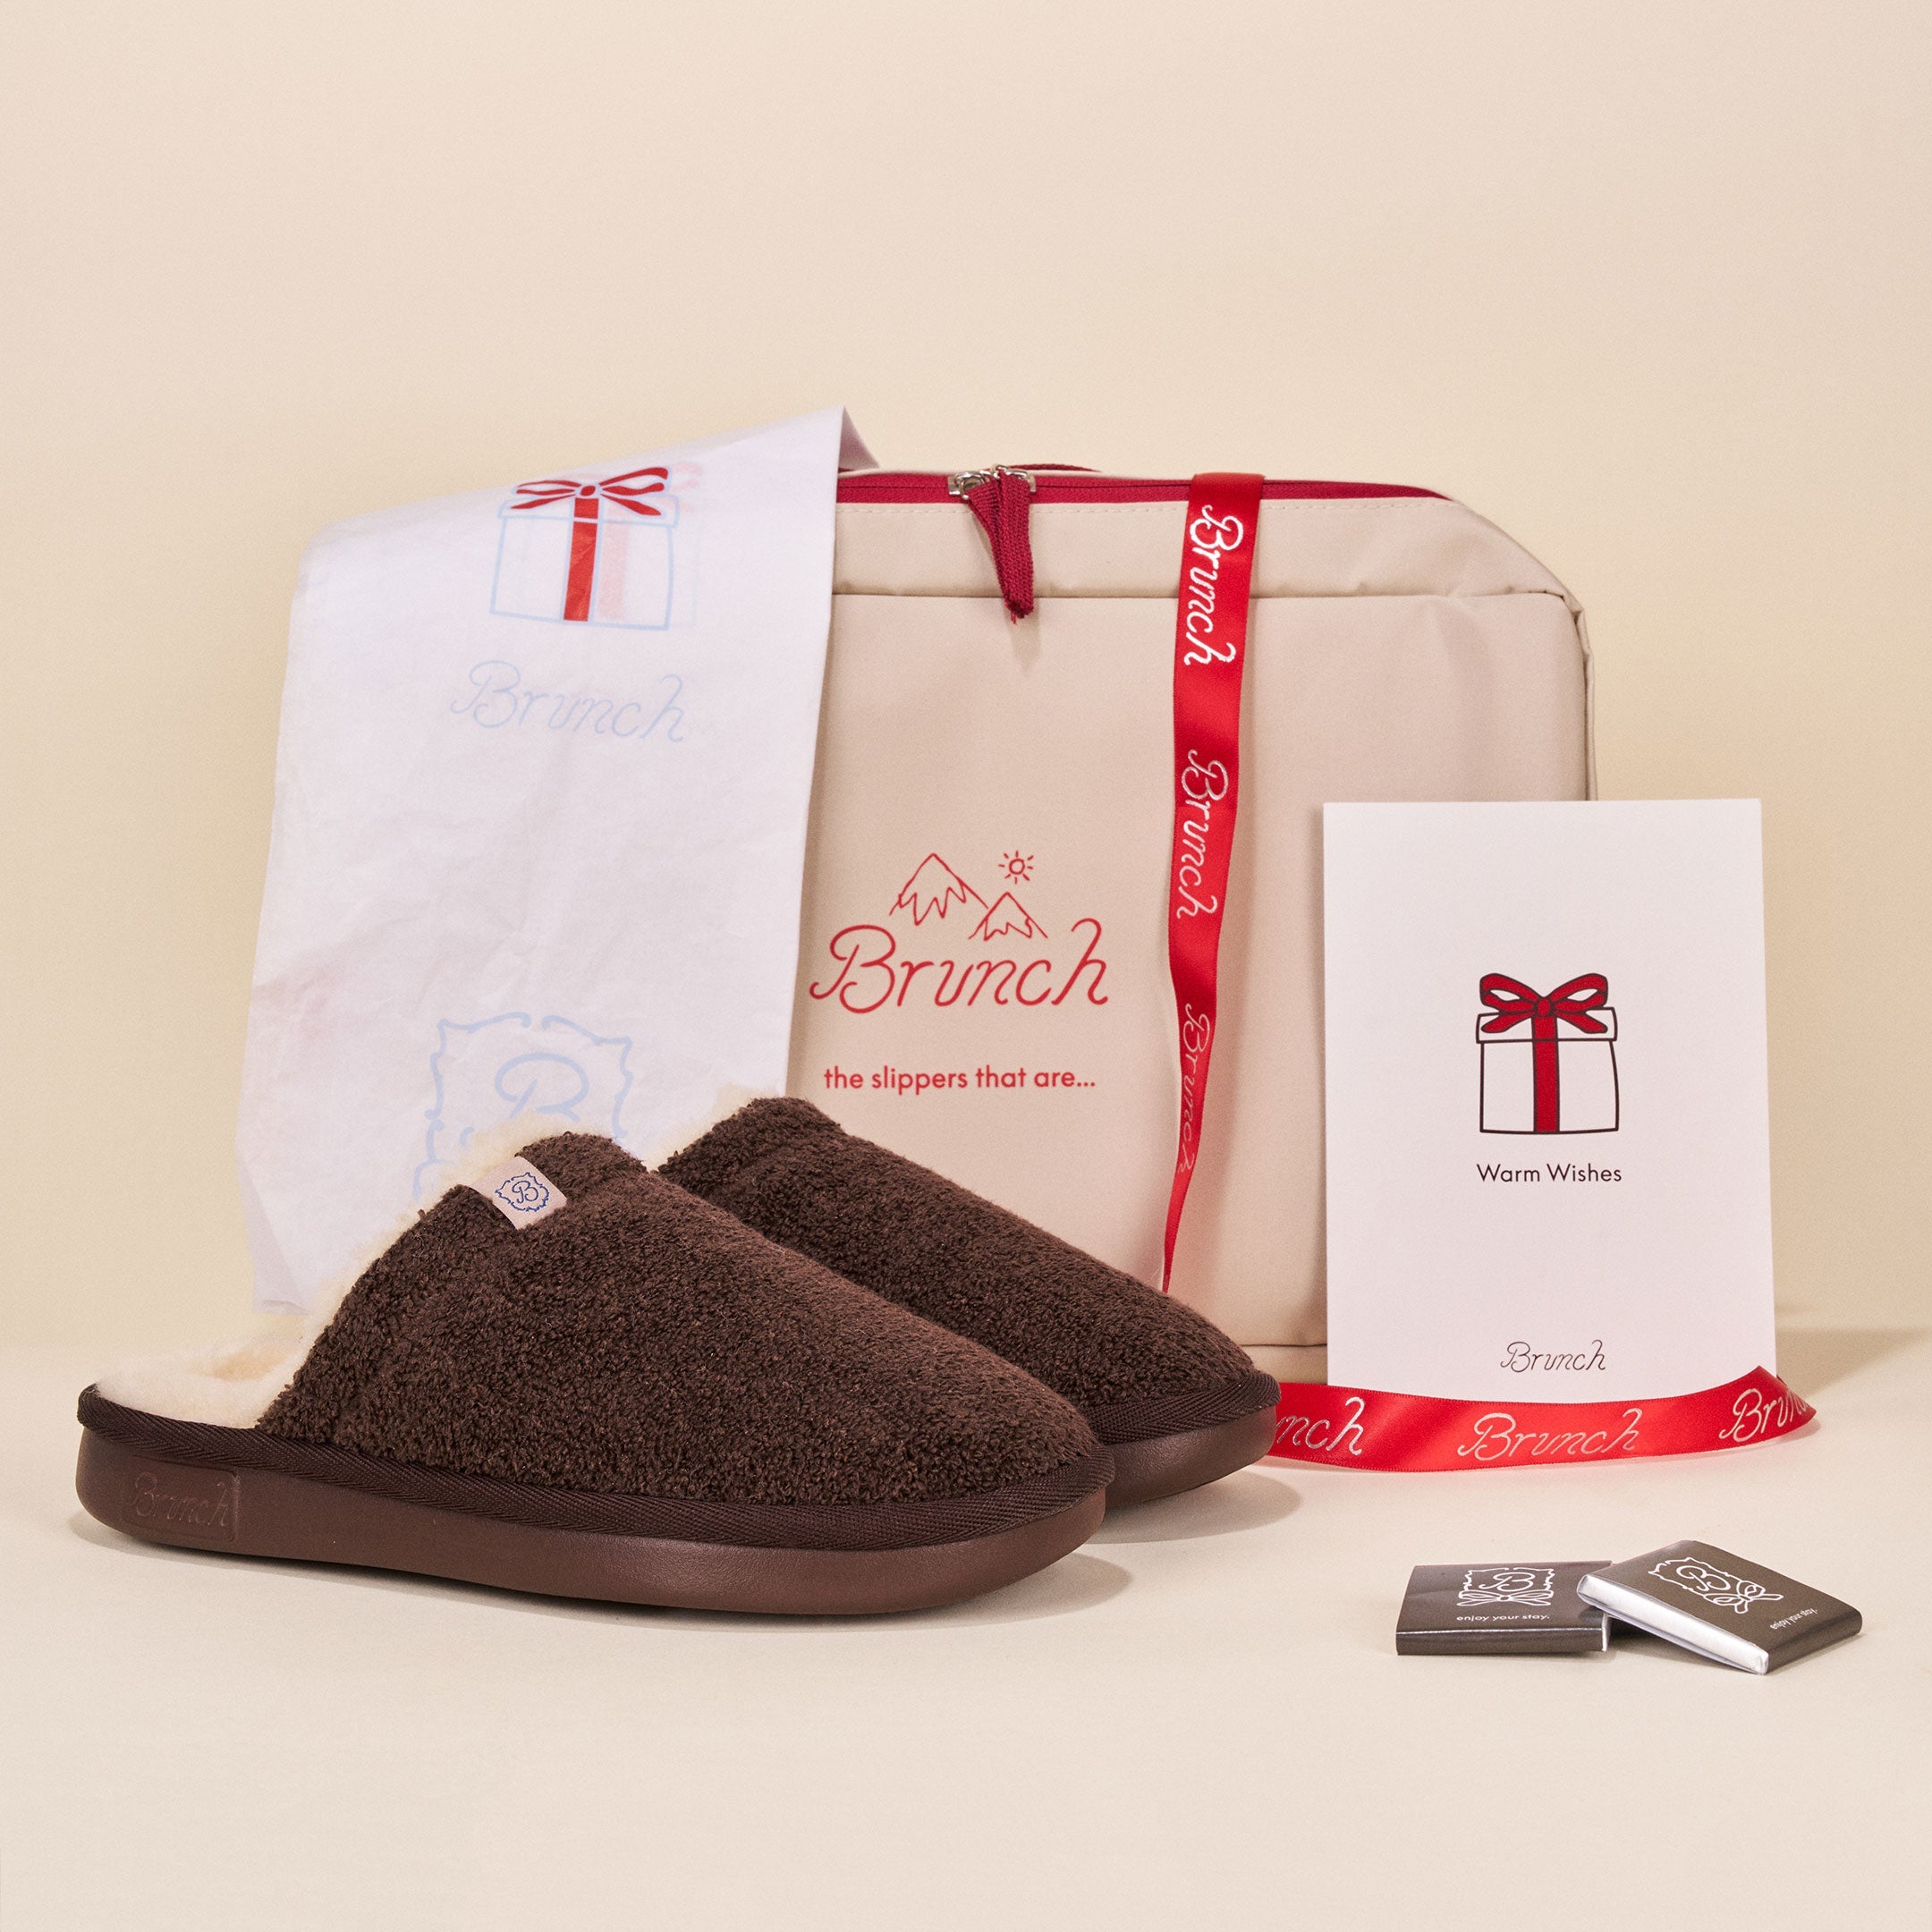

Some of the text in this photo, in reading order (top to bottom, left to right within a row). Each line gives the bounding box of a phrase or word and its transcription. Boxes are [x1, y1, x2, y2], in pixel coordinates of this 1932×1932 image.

[1183, 504, 1244, 665] Brunch
[450, 660, 685, 741] Brunch
[1176, 749, 1229, 919] Brunch
[809, 918, 1108, 1014] Brunch
[824, 1064, 1096, 1095] the slippers that are...
[1177, 1003, 1210, 1174] Brunch
[512, 1180, 539, 1204] B
[1476, 1163, 1623, 1182] Warm Wishes
[1500, 1339, 1606, 1373] Brunch
[1275, 1396, 1365, 1456] nch
[1457, 1408, 1642, 1462] Brunch
[1479, 1572, 1536, 1592] B
